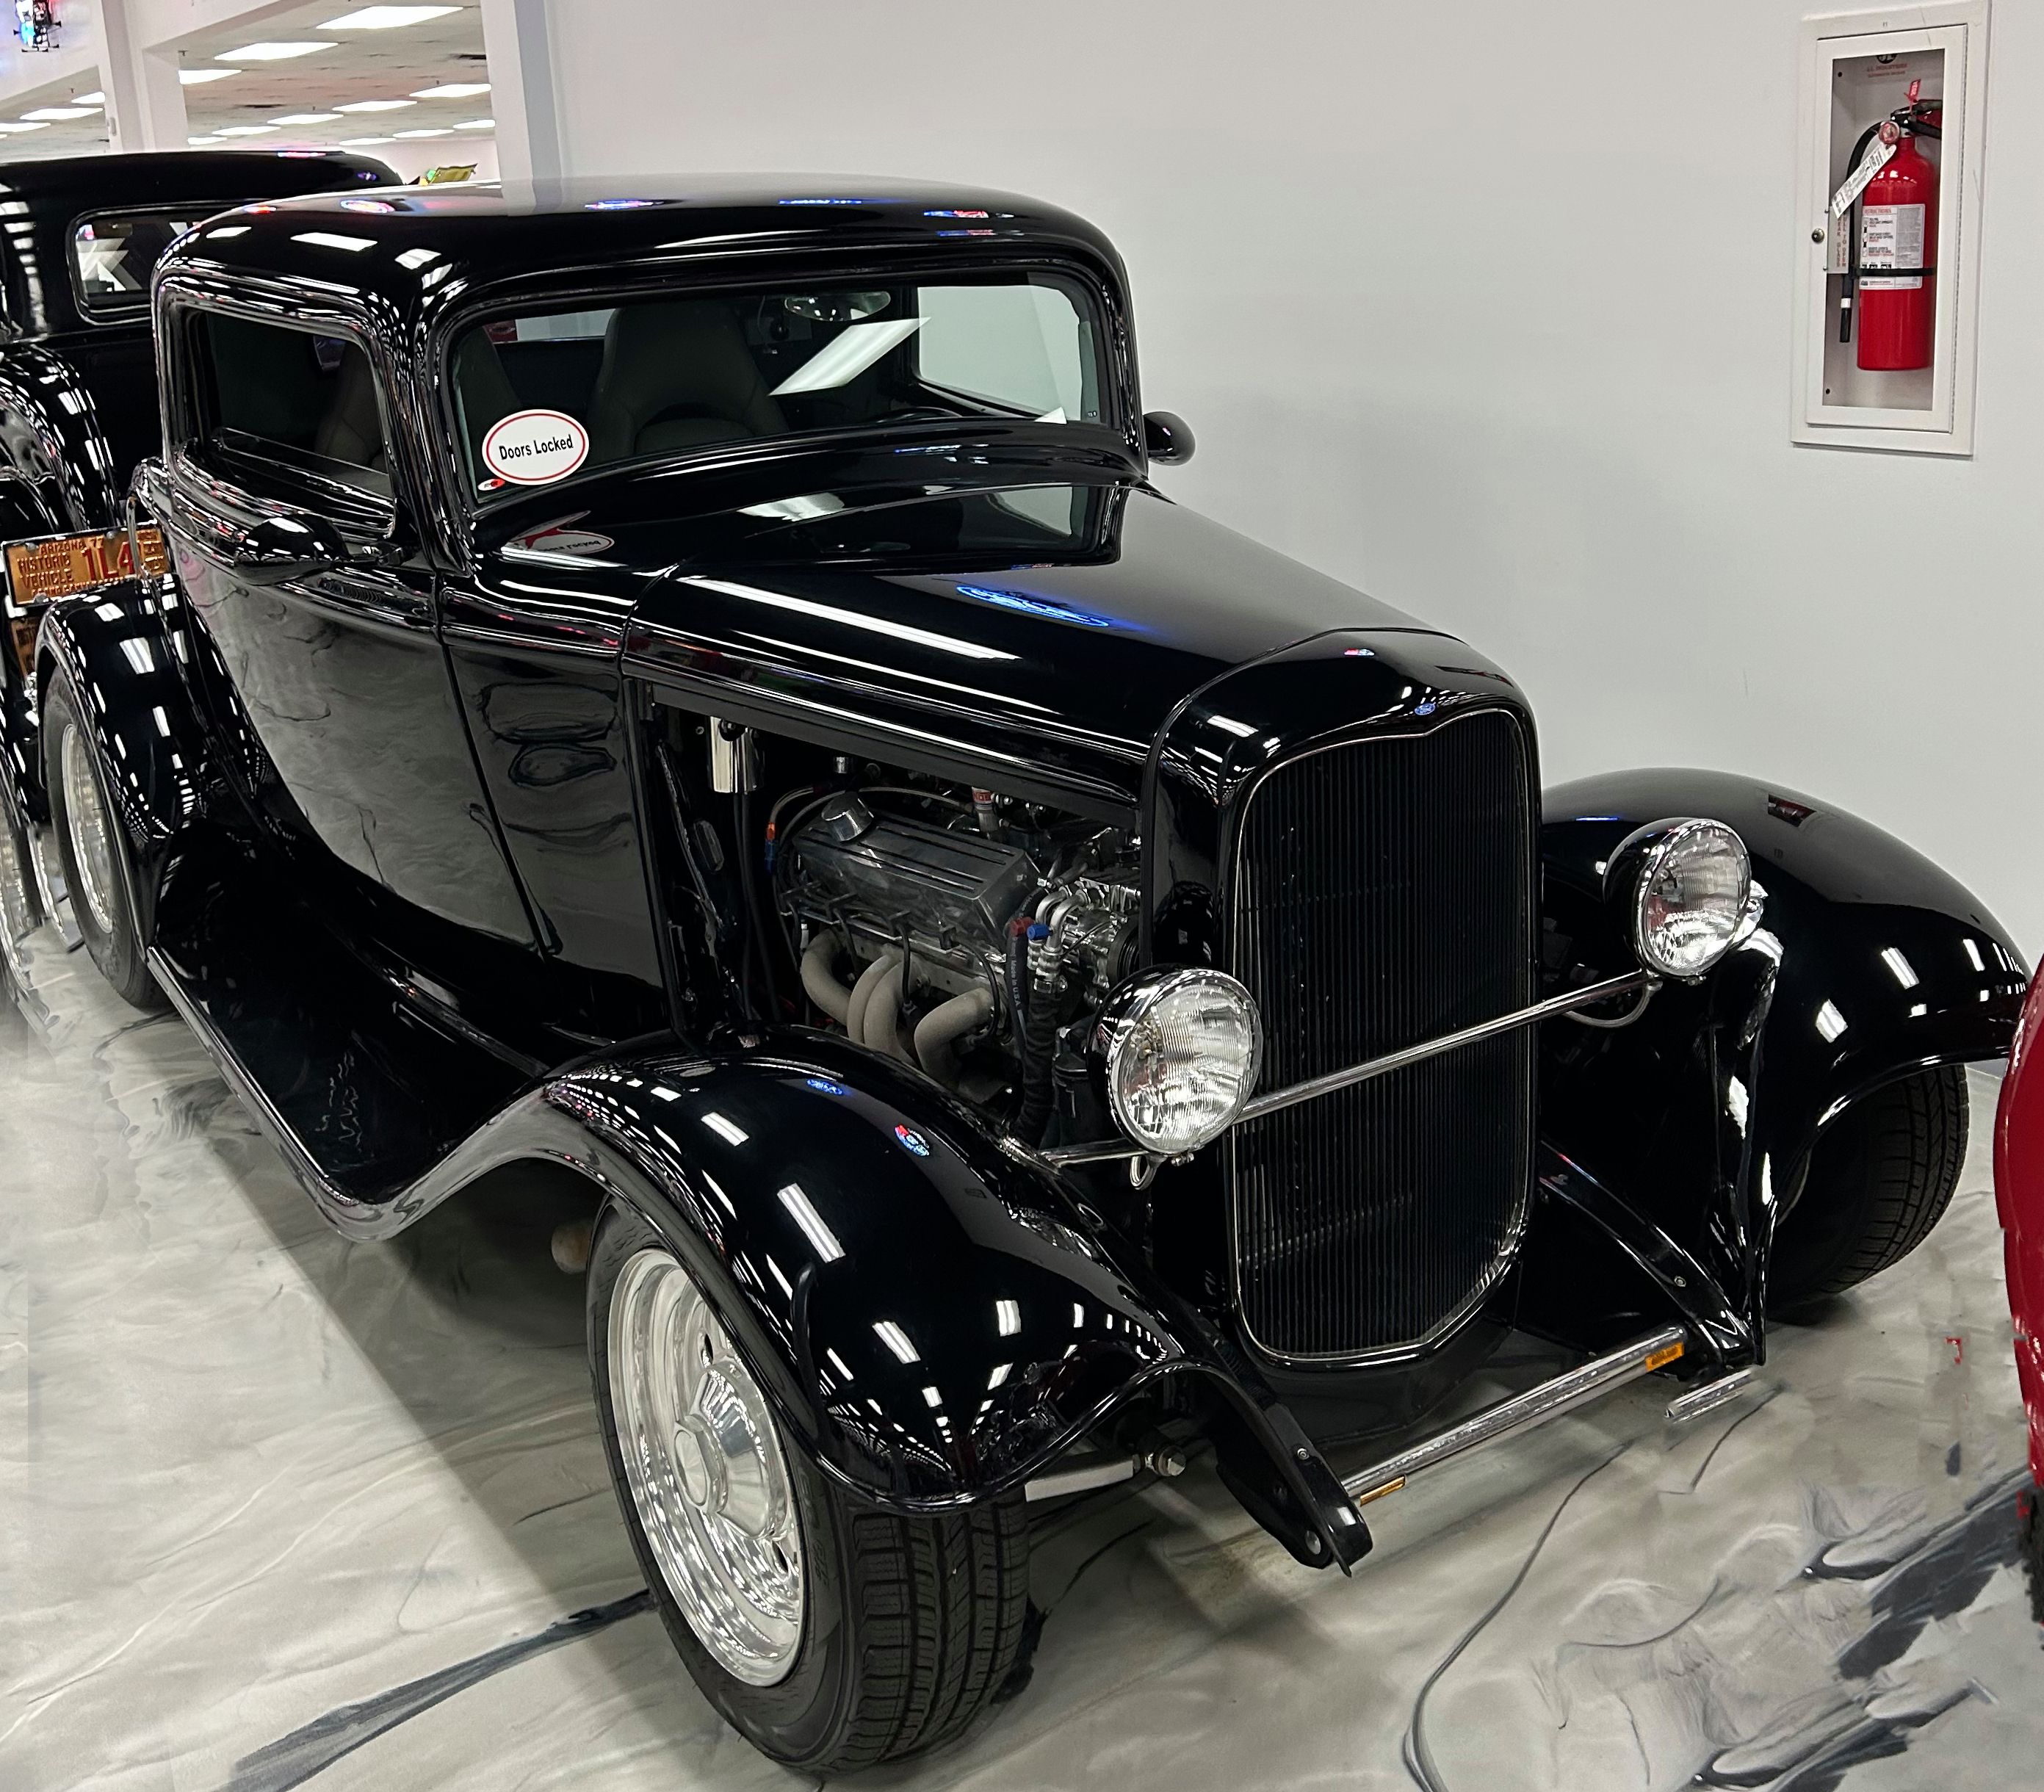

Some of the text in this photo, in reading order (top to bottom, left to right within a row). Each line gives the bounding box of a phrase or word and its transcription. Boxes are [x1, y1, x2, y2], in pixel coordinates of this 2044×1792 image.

[499, 434, 574, 460] Doors Locked
[40, 539, 87, 555] ARIZONA
[17, 552, 71, 573] HISTORIC
[81, 541, 141, 581] 1L4
[20, 568, 74, 588] VEHICLE
